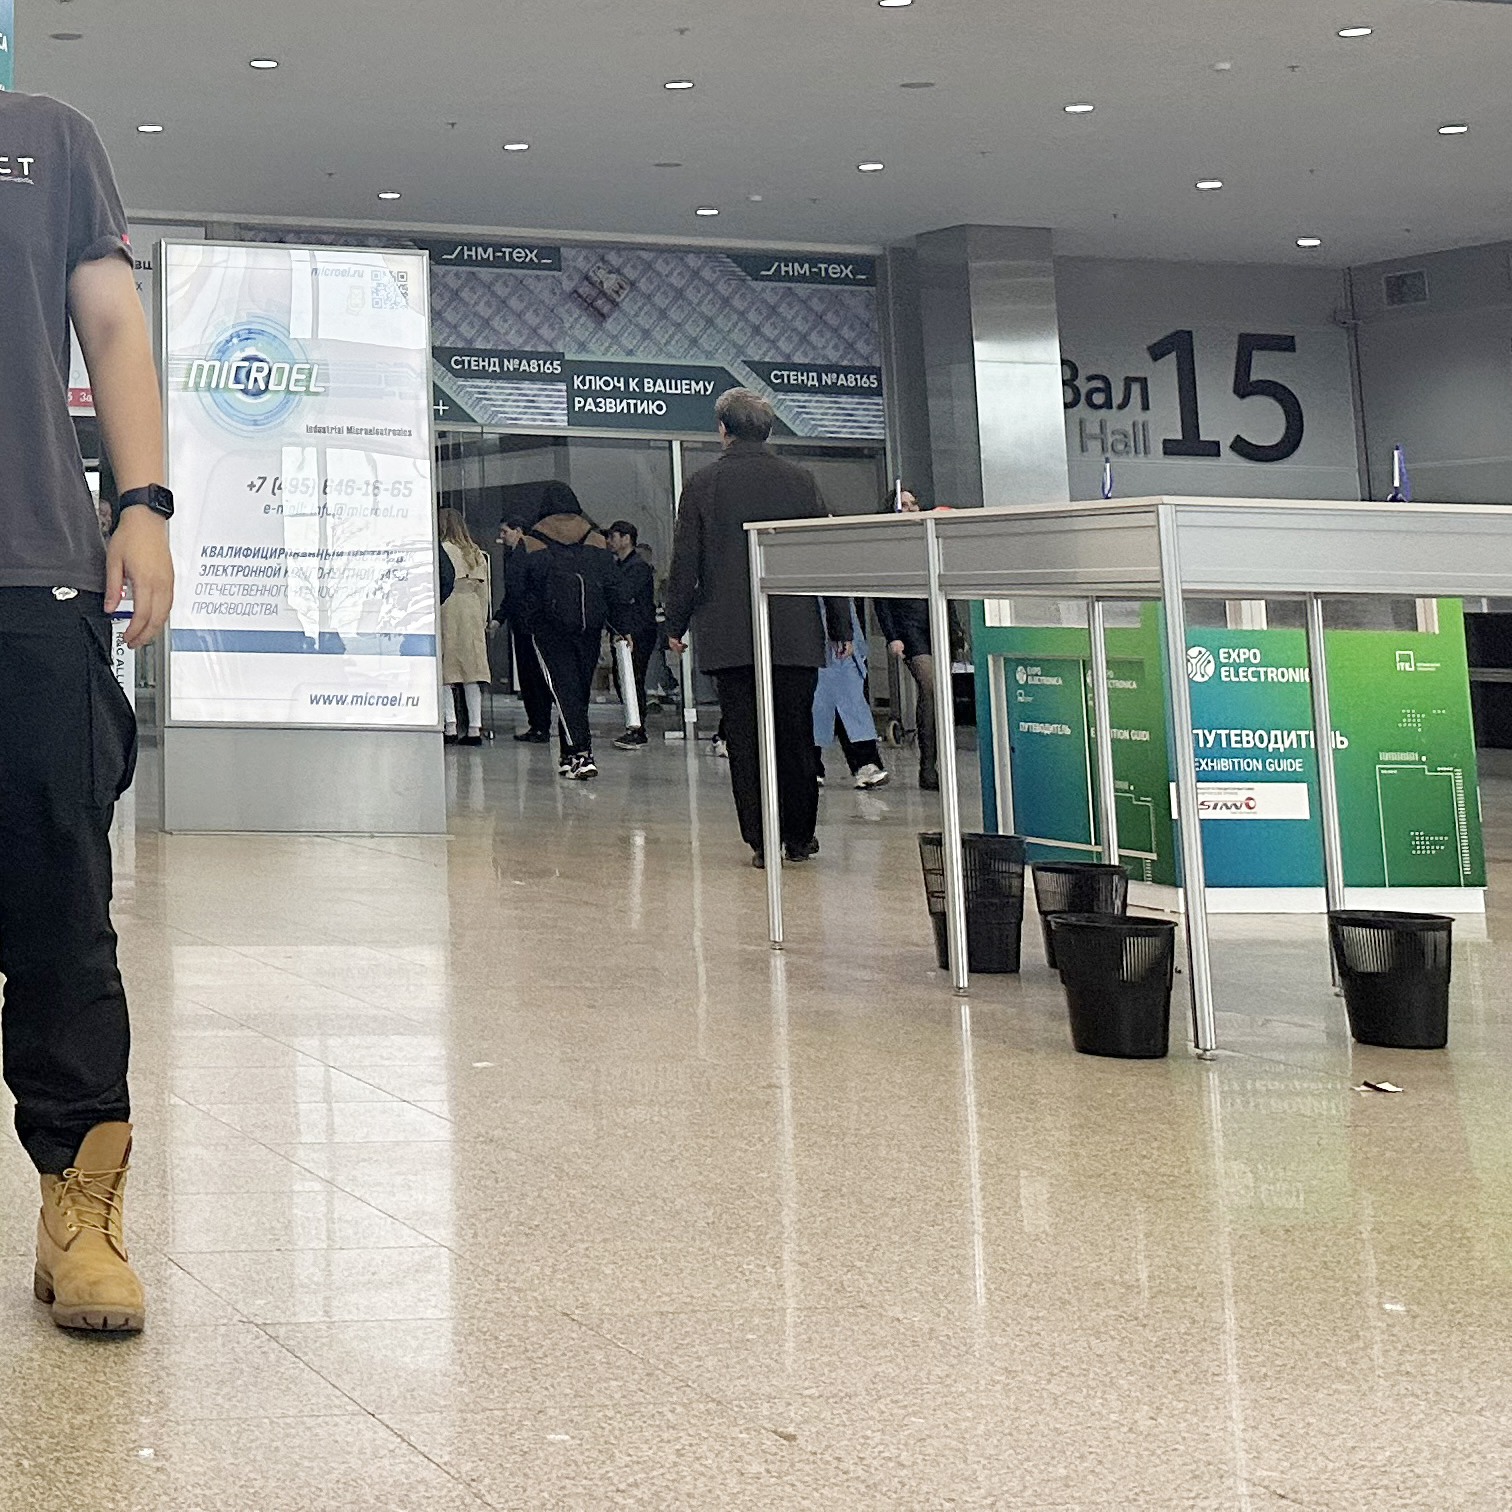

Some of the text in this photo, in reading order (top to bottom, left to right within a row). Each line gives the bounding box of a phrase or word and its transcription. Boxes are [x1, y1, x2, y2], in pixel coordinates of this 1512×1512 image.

[450, 356, 500, 373] СТЕНД
[188, 358, 327, 394] MICROEL
[573, 374, 714, 396] КЛЮЧ К ВАШЕМУ
[770, 370, 819, 387] СТЕНД
[1146, 329, 1304, 462] 15
[574, 397, 667, 416] РАЗВИТИЮ
[1079, 417, 1151, 456] Hall
[246, 476, 267, 494] +7
[199, 562, 280, 579] ЭЛЕКТРОННОЙ
[191, 601, 278, 617] ПРОИЗВОДСТВА
[1218, 648, 1261, 664] EXPO
[309, 690, 420, 709] www.microel.ru
[1265, 758, 1304, 772] GUIDE
